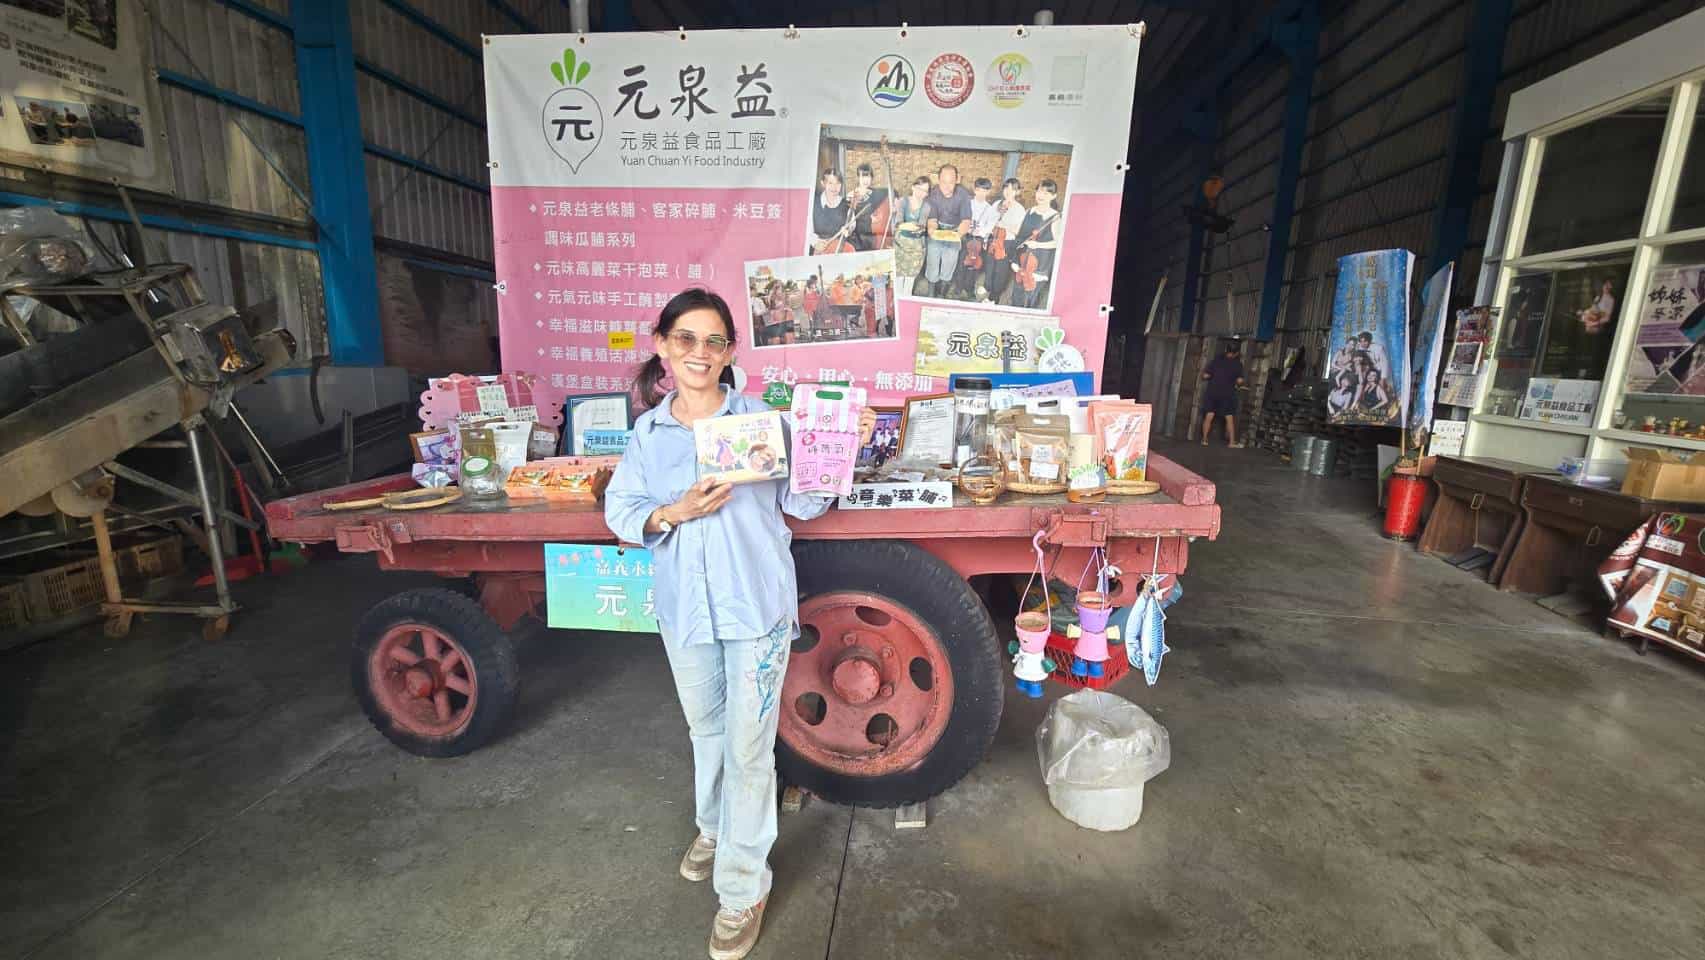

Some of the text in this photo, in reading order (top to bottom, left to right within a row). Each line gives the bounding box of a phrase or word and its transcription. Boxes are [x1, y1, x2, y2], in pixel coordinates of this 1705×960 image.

[613, 63, 776, 121] 元泉益
[552, 105, 594, 141] 元
[620, 131, 767, 151] 元泉益食品工廠
[620, 155, 766, 169] Yuan Chuan Yi Food Industry
